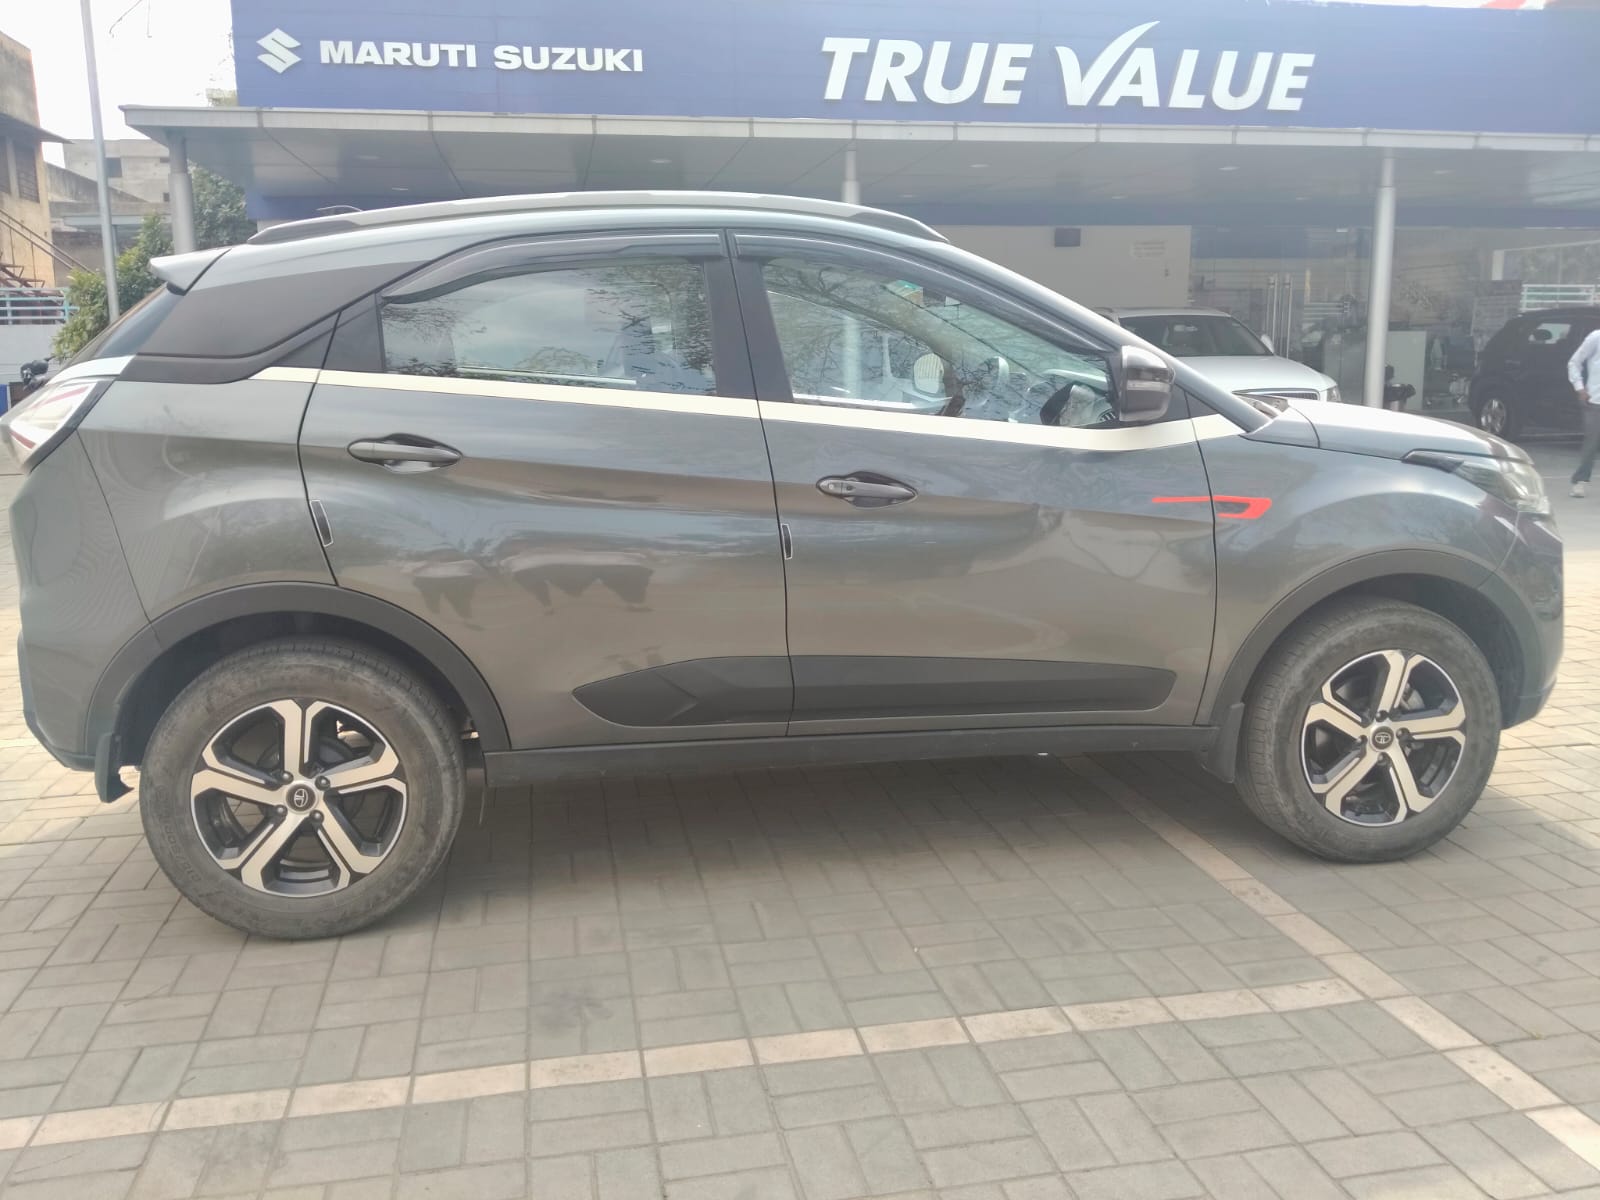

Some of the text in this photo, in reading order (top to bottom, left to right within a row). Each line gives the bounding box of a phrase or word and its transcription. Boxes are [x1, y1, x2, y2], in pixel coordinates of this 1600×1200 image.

[319, 40, 644, 73] MARUTI SUZUKI
[821, 20, 1316, 111] TRUE VALUE
